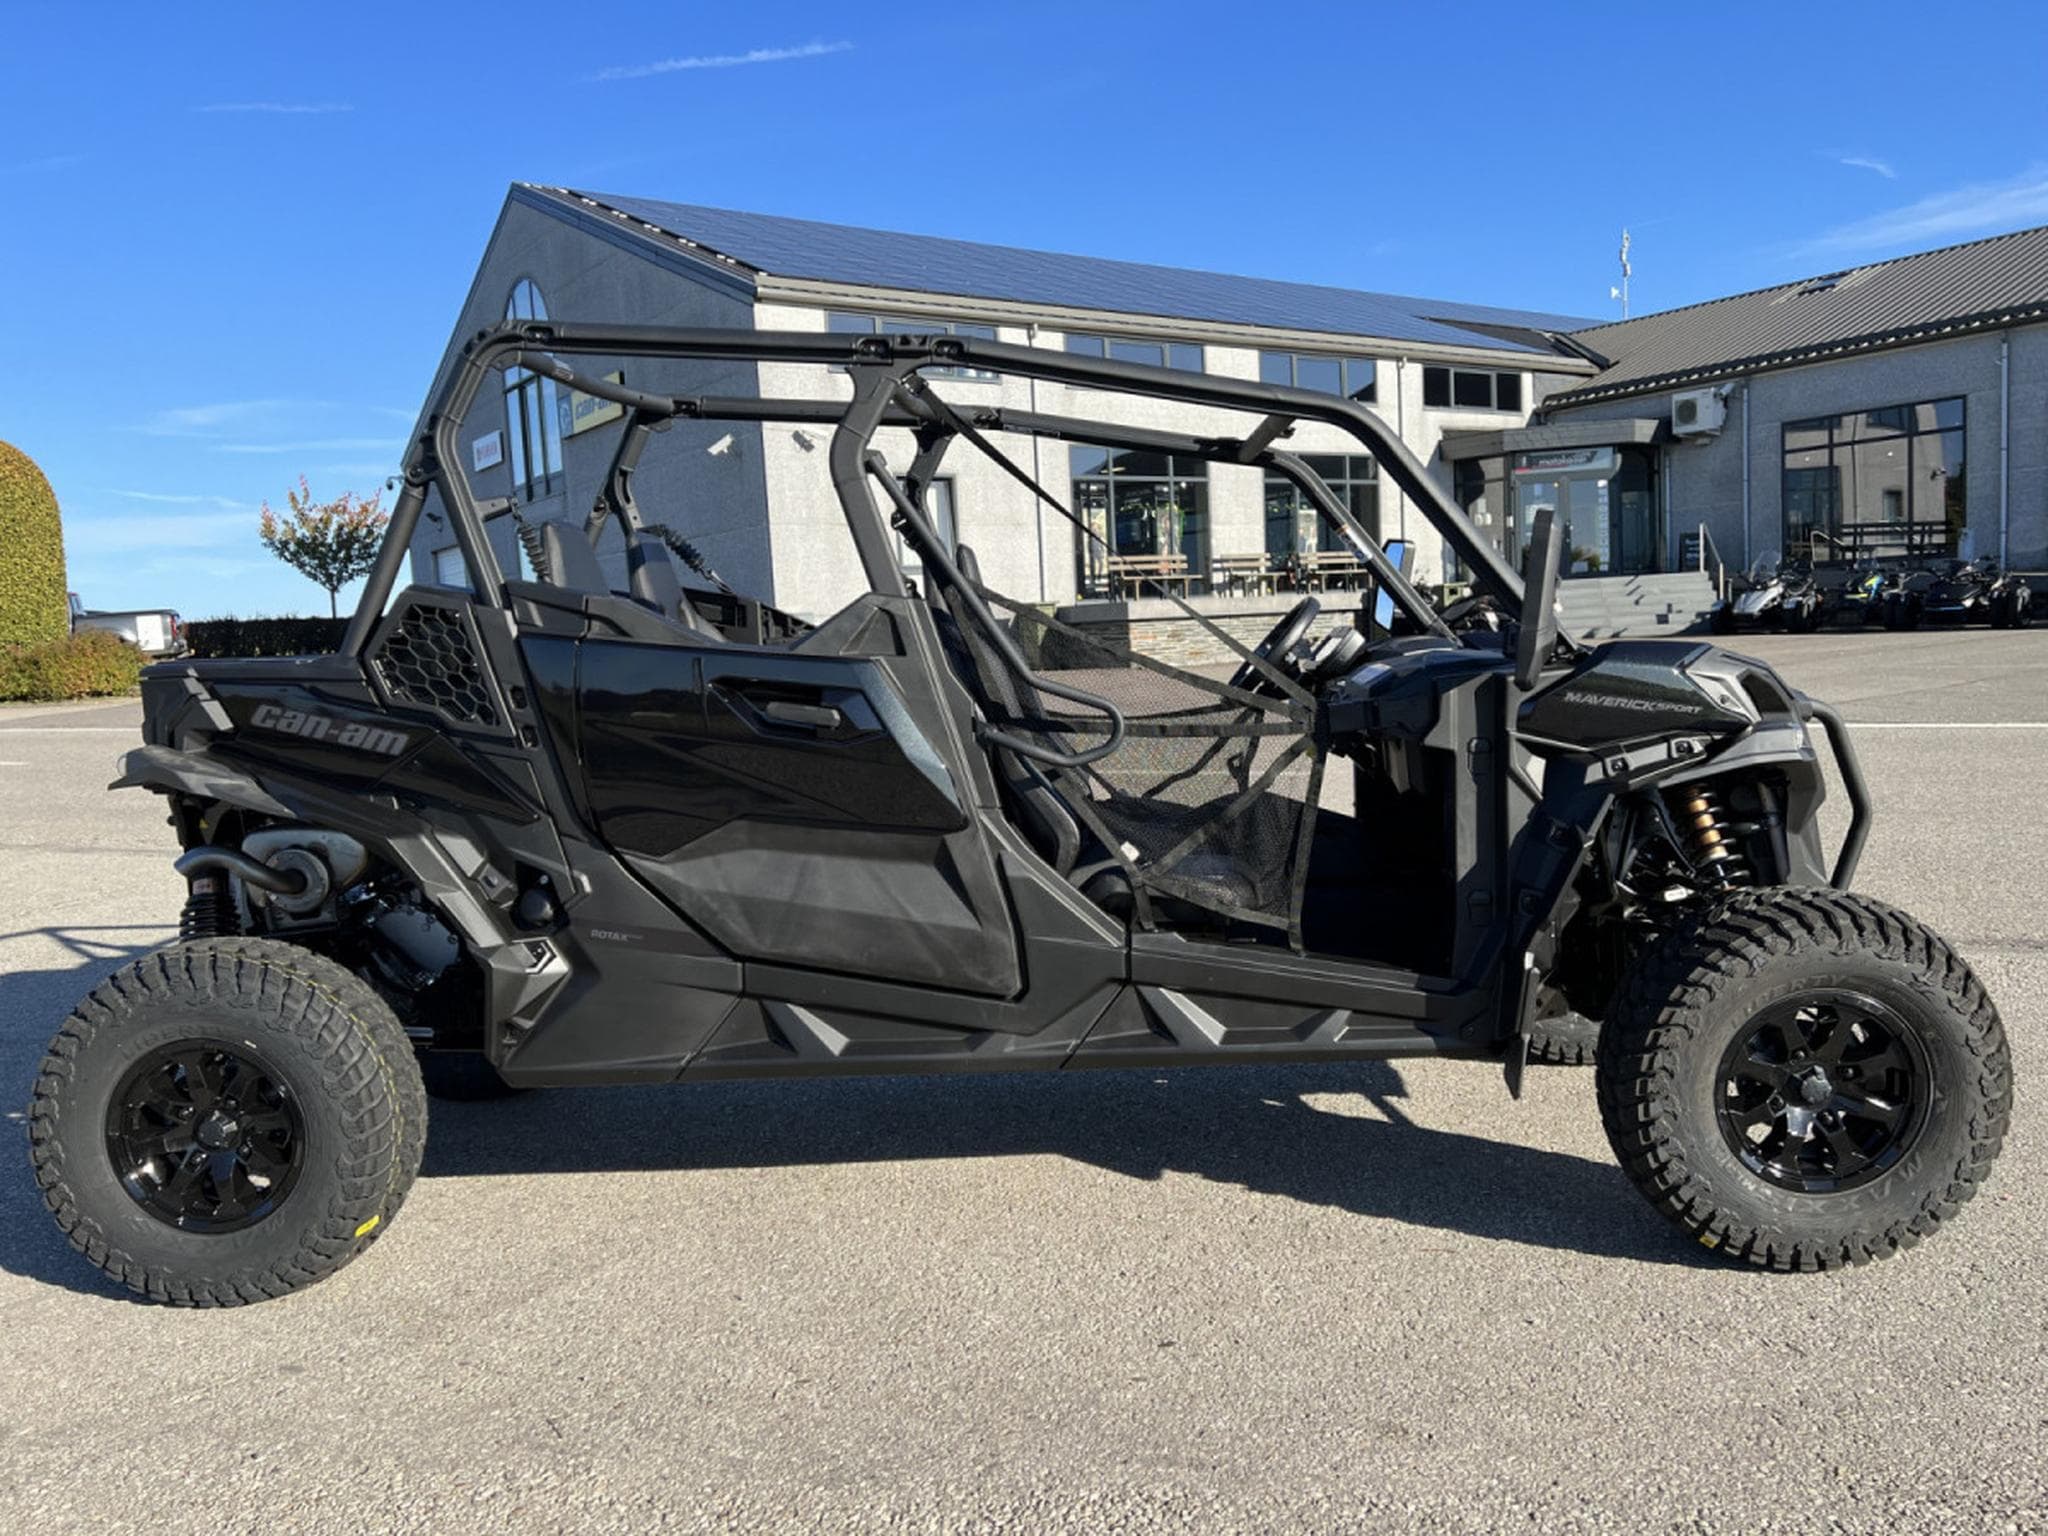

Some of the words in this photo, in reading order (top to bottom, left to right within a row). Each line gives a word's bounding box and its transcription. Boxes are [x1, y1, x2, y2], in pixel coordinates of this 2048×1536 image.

[1563, 691, 1657, 712] MAVERICK
[1655, 702, 1705, 715] SPORT
[250, 703, 410, 756] can-am
[591, 928, 629, 942] ROTAX
